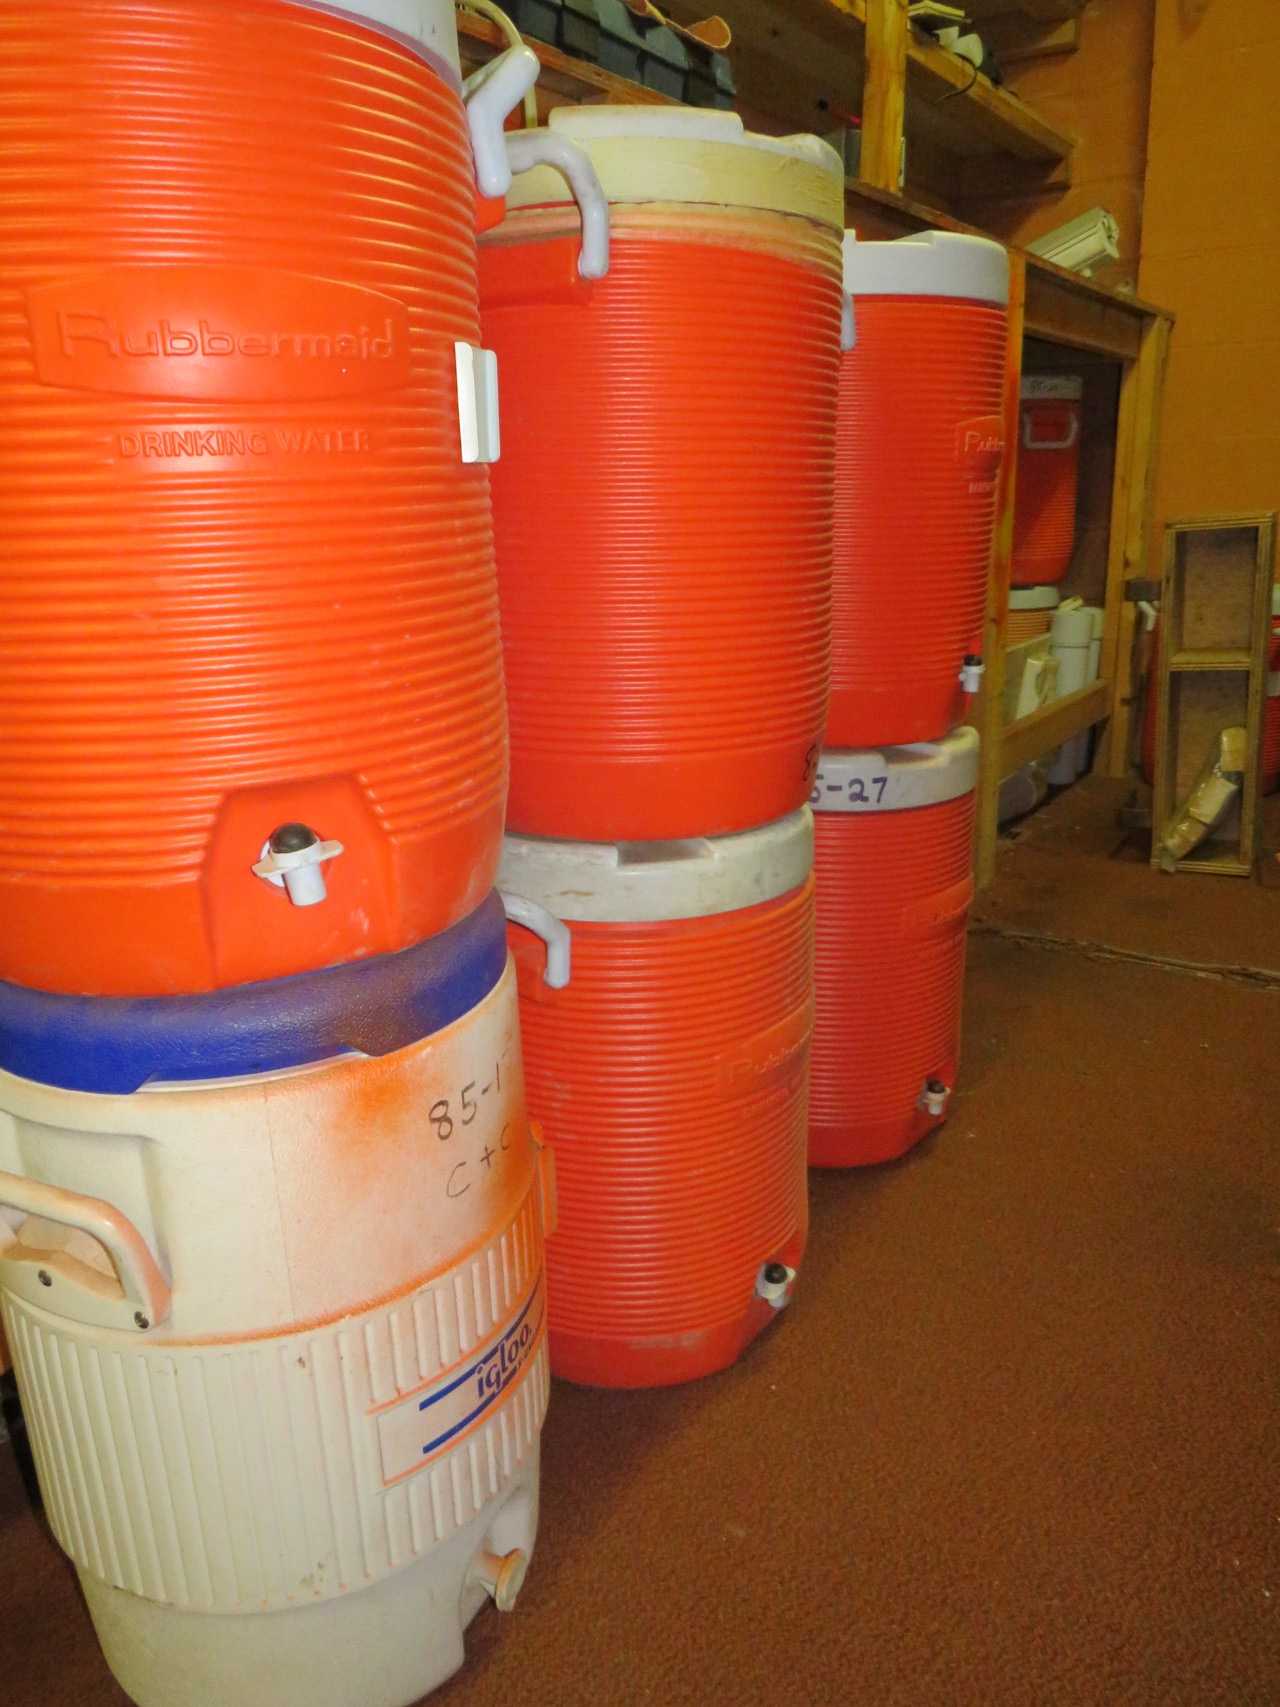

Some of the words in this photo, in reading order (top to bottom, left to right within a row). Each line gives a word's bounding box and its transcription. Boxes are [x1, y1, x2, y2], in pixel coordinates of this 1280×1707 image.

[56, 308, 395, 361] Rubbermaid
[119, 428, 270, 460] DRINKING
[275, 427, 371, 453] WATER
[474, 1322, 531, 1398] igloo
